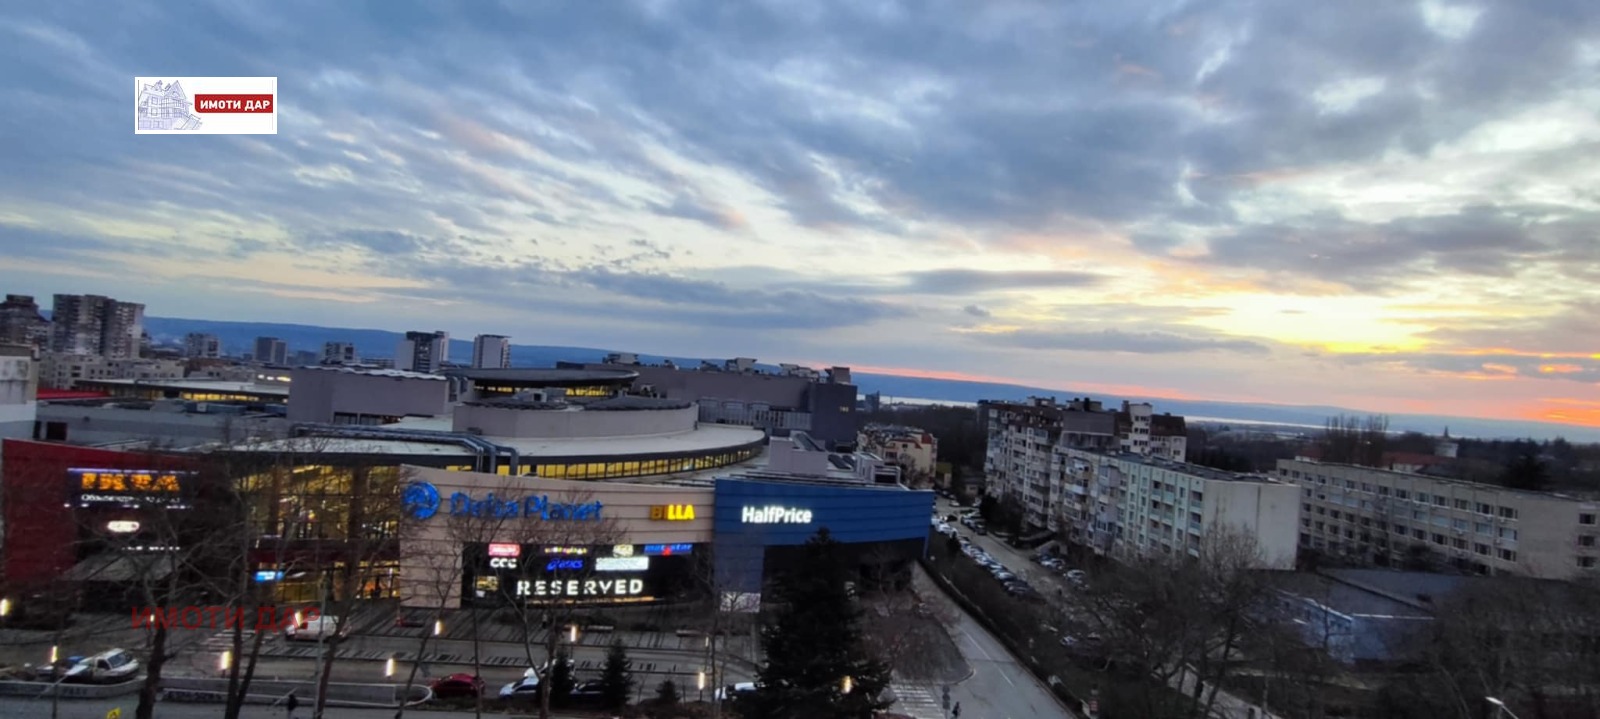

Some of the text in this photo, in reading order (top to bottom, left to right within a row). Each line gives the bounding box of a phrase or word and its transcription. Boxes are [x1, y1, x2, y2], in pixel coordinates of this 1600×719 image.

[650, 504, 695, 520] BILLA
[741, 506, 812, 523] HalfPrice
[490, 558, 517, 568] CCC
[516, 579, 644, 596] RESERVED
